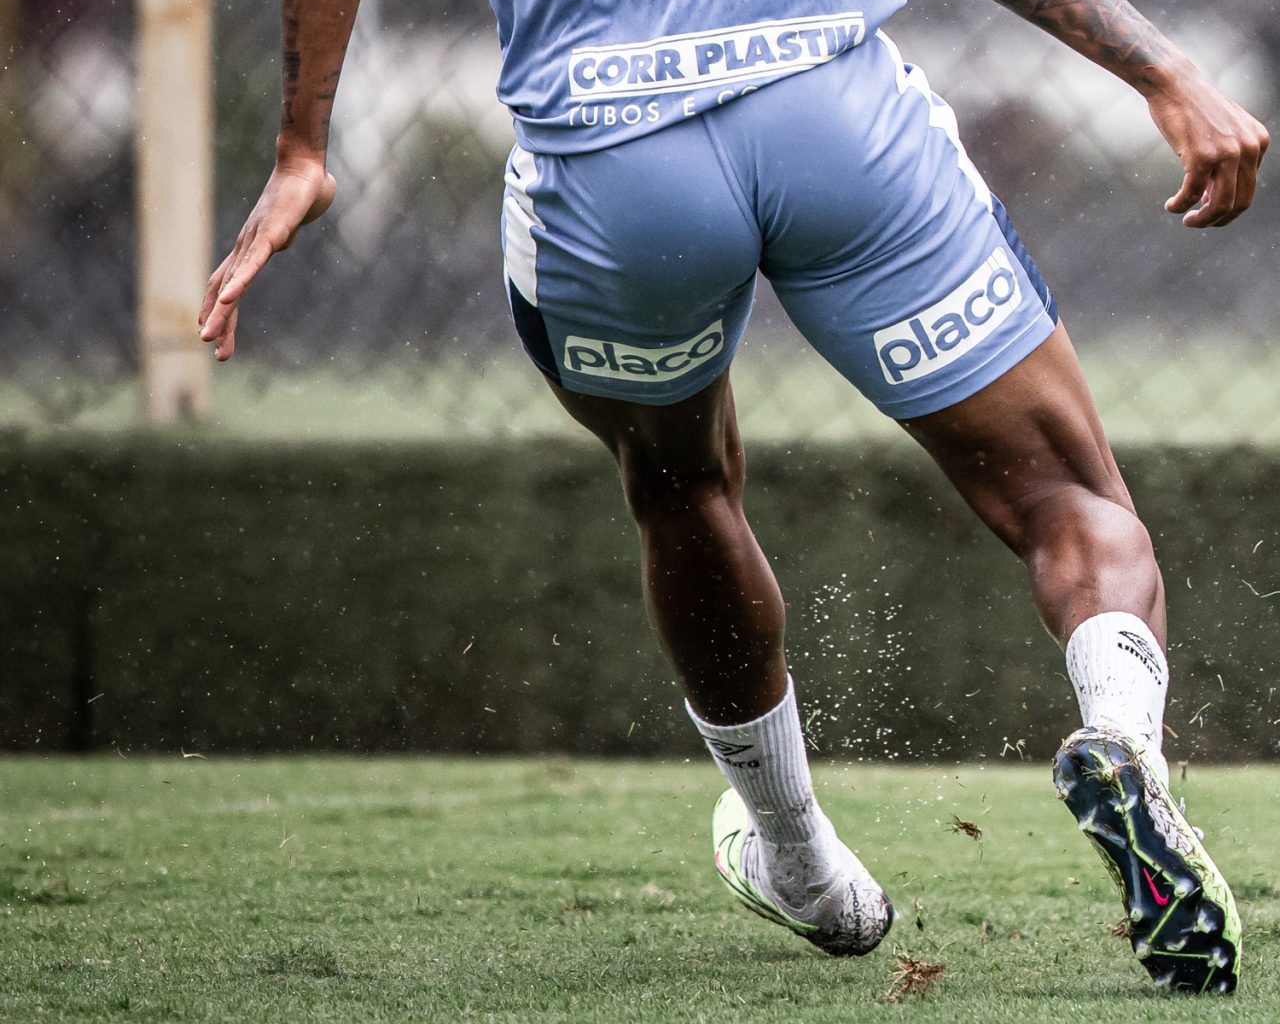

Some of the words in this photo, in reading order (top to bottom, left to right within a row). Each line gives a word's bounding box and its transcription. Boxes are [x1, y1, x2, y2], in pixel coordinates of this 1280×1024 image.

[572, 48, 686, 91] CORR
[683, 96, 697, 117] E
[877, 259, 1018, 379] placo
[567, 324, 724, 373] placo
